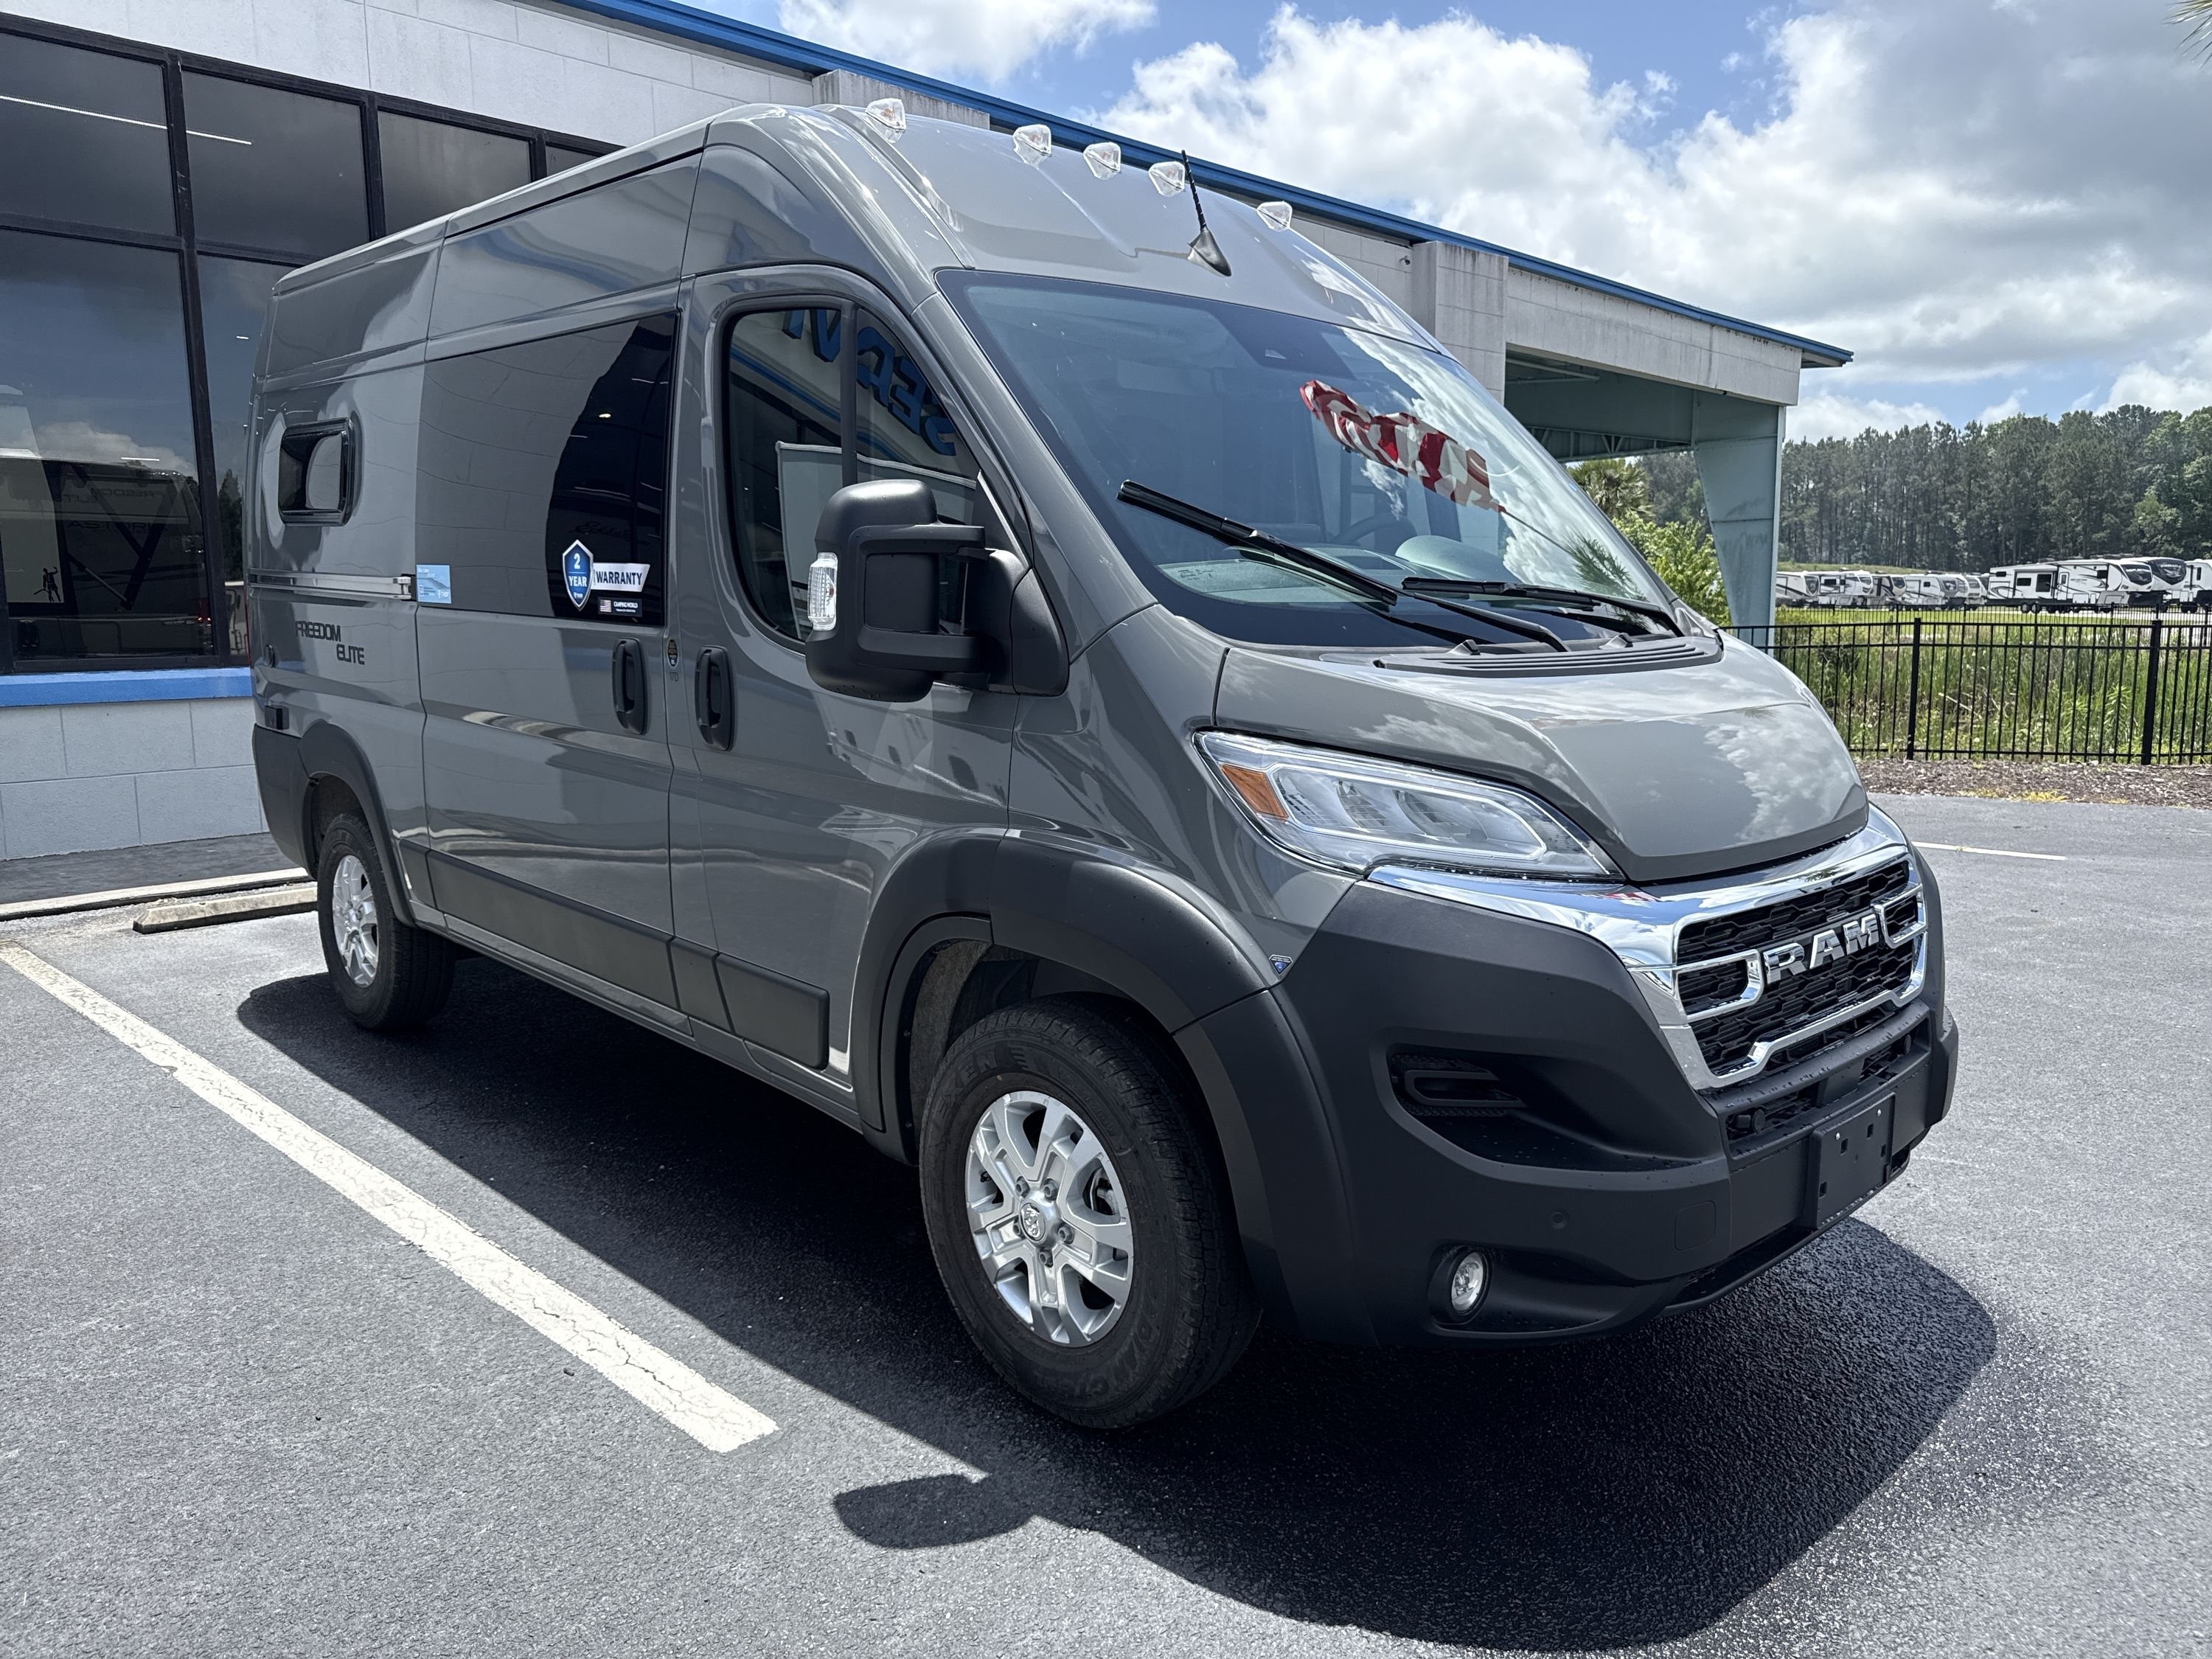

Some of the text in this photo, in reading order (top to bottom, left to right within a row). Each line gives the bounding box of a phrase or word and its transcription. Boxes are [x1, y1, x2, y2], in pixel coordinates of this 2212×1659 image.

[574, 553, 580, 569] 2
[568, 576, 587, 587] YEAR
[596, 571, 642, 585] WARRANTY
[295, 620, 341, 642] FREEDOM
[336, 644, 365, 665] ELITE
[1763, 914, 1880, 985] RAM
